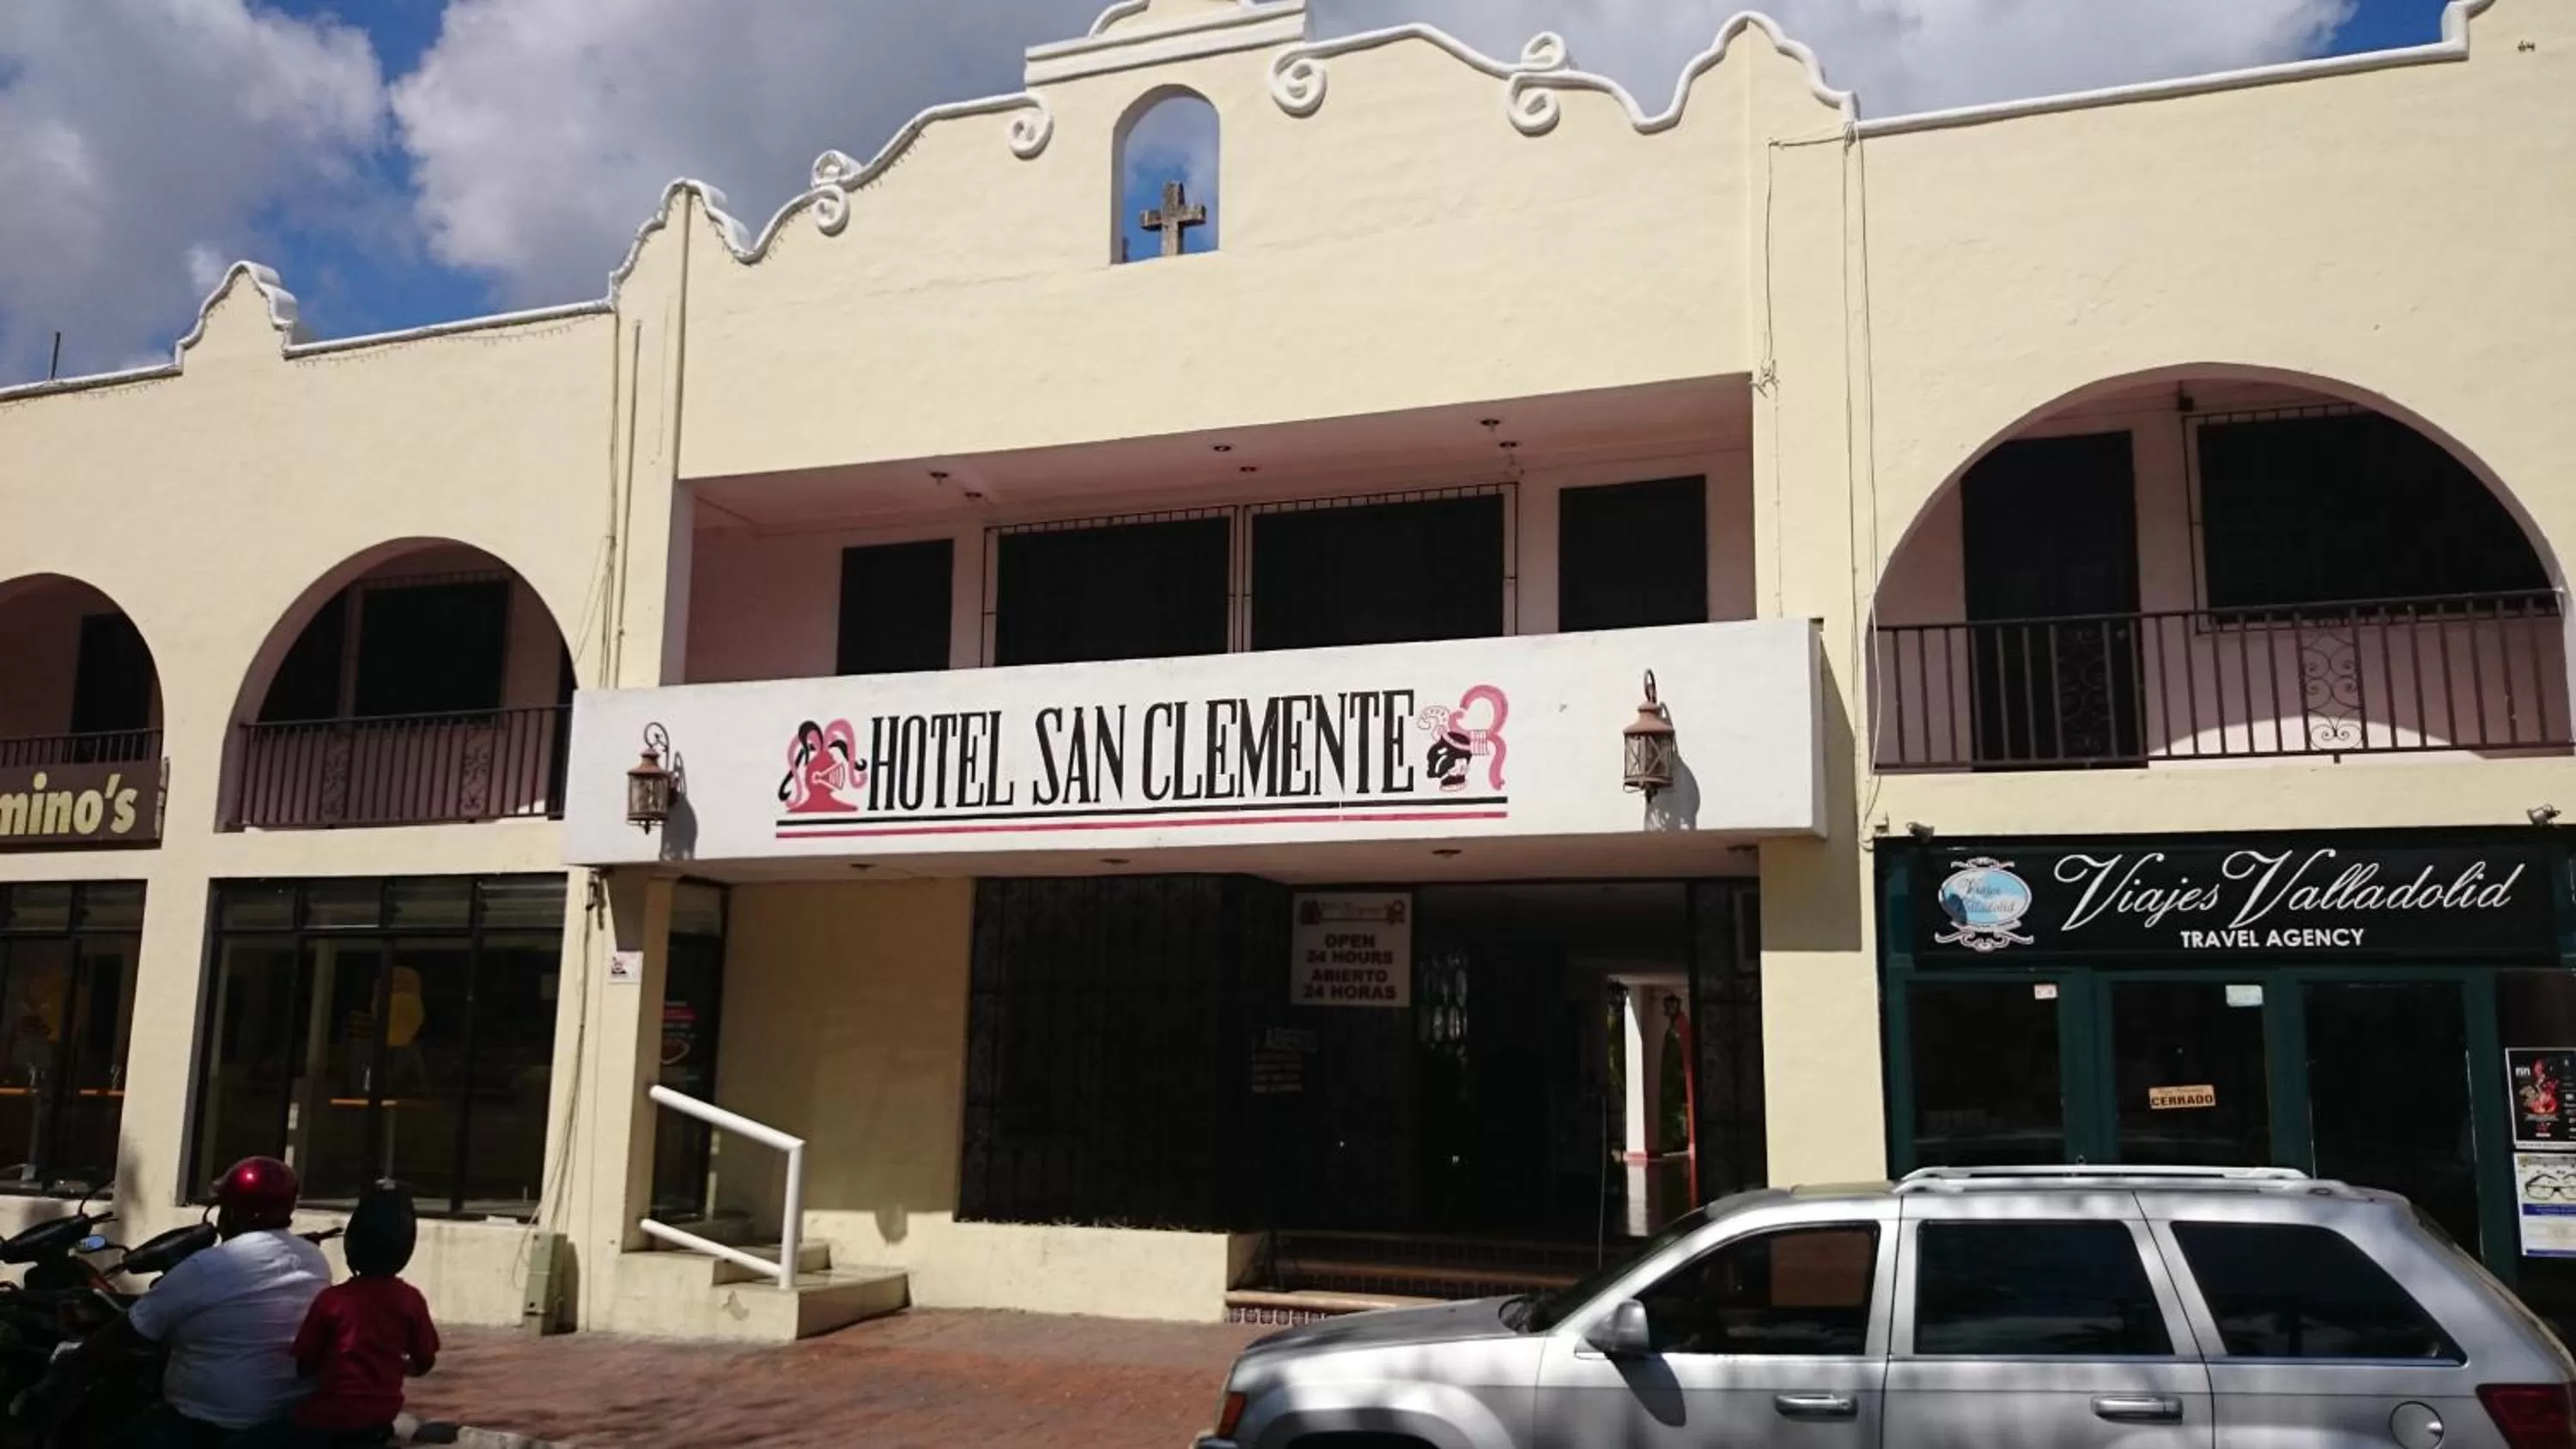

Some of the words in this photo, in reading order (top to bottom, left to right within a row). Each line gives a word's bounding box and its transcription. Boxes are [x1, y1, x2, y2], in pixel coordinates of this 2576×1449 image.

[867, 710, 1014, 811] HOTEL
[1032, 705, 1127, 806] SAN
[1141, 688, 1415, 801] CLEMENTE
[2053, 852, 2220, 931] Viajes
[2221, 848, 2526, 930] Valladolid
[1325, 933, 1376, 949] OPEN
[2180, 930, 2259, 949] TRAVEL
[2266, 928, 2365, 948] AGENCY
[1307, 949, 1327, 963] 24
[1332, 950, 1394, 965] HOURS
[1311, 968, 1388, 983] ABIERTO
[1303, 985, 1324, 999] 24
[1331, 985, 1396, 1000] HORAS
[2151, 1094, 2213, 1106] CERRADO
